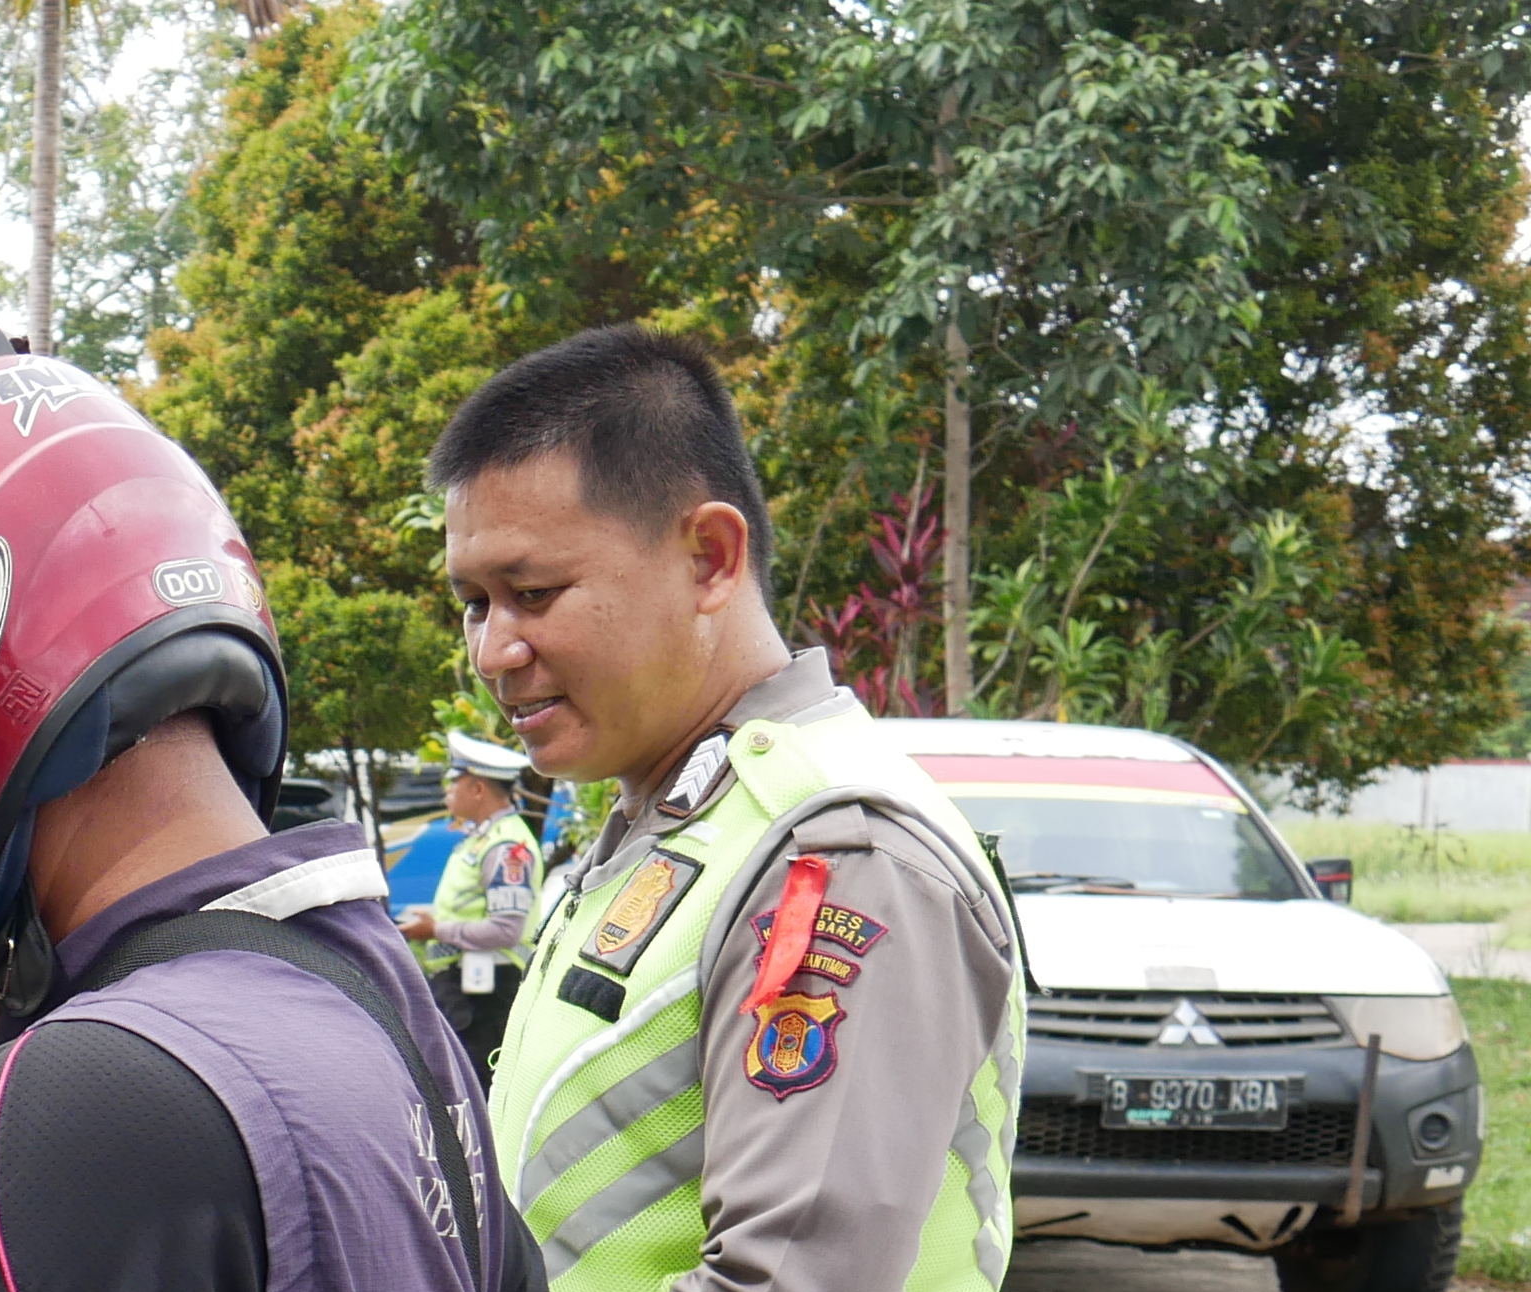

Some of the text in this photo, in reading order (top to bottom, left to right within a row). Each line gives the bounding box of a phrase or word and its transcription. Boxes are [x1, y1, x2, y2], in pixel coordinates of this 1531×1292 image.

[163, 567, 216, 598] DOT
[820, 906, 863, 930] RES
[815, 920, 867, 947] BARAT
[1111, 1080, 1279, 1112] B 9370 KBA
